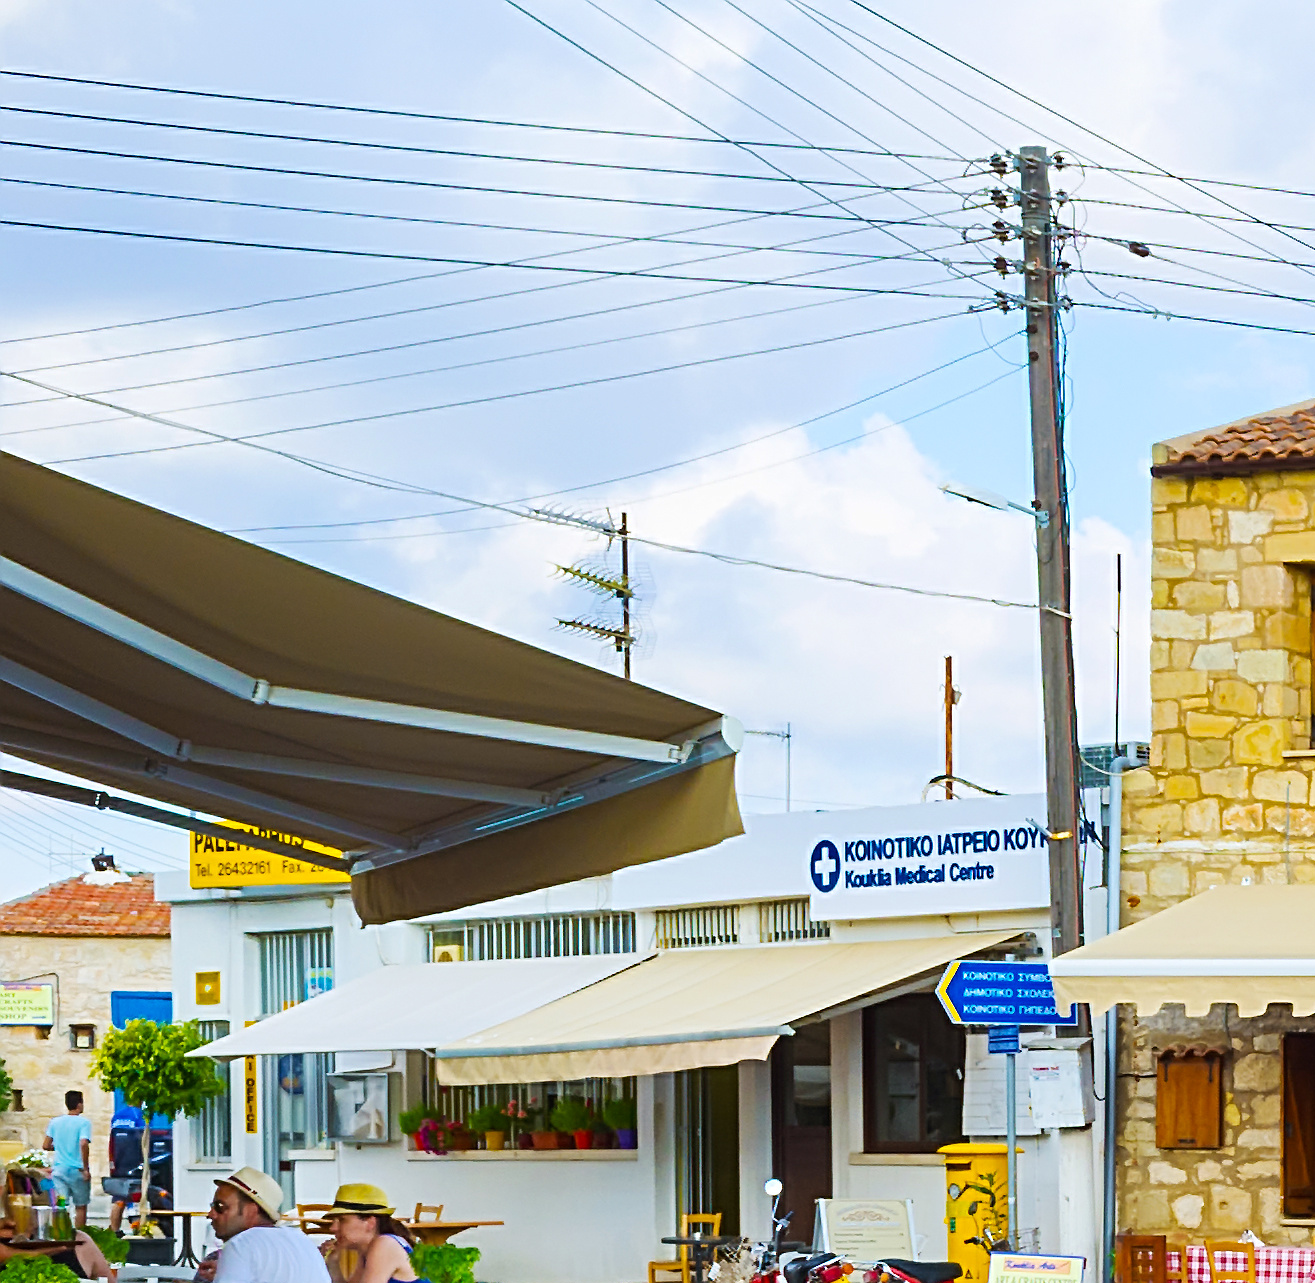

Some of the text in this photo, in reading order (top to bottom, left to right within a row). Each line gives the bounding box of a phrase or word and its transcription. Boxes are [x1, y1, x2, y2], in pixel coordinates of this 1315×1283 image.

[844, 834, 933, 863] ΚΟΙΝΟΤΙΚΟ
[938, 829, 1000, 856] ΙΑΤΡΕΙΟ
[217, 861, 271, 877] 26432161
[845, 861, 995, 889] Kouklia Medical Centre
